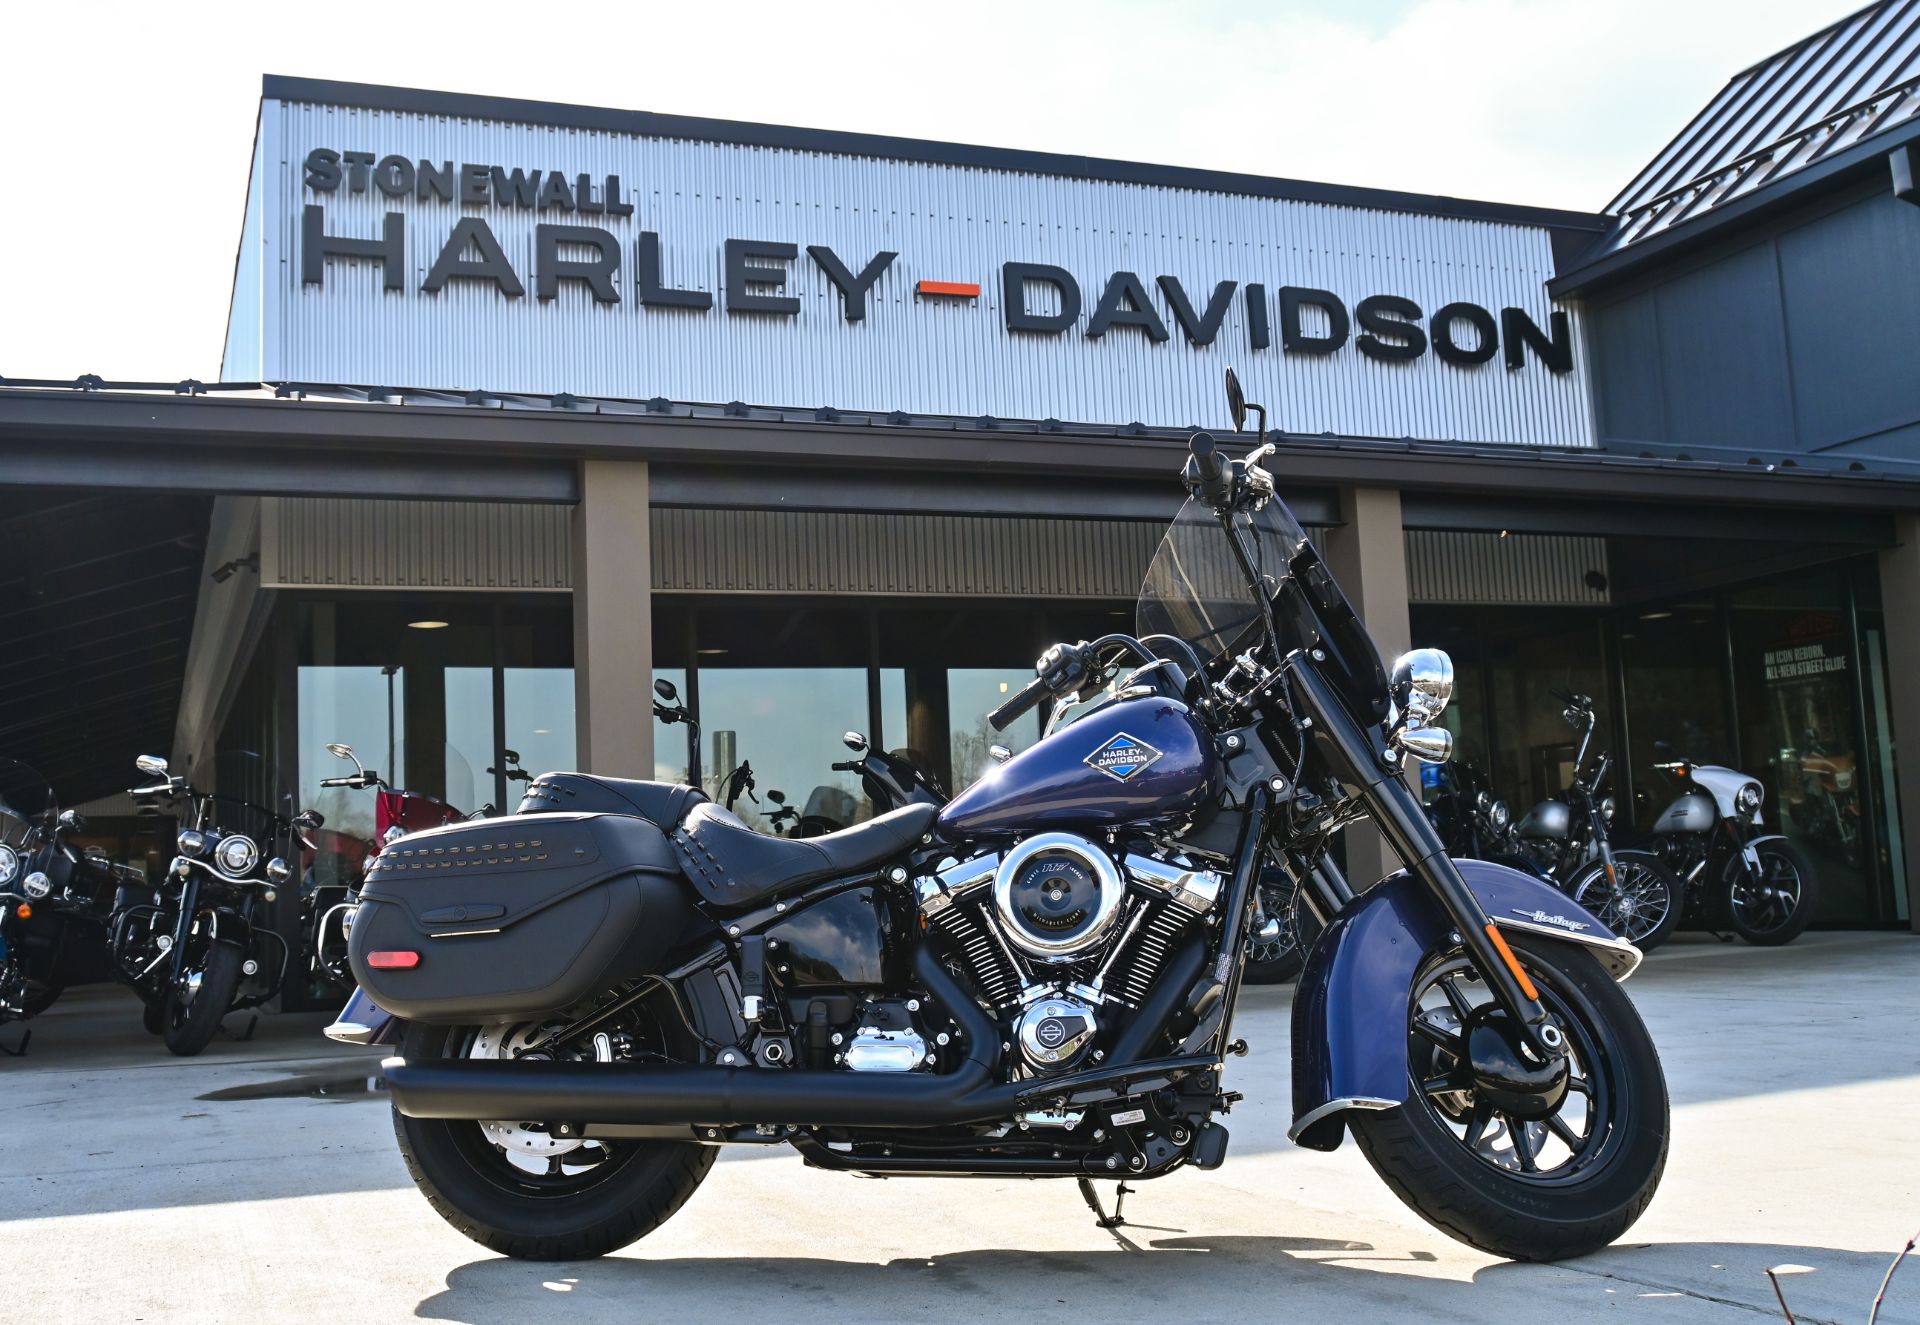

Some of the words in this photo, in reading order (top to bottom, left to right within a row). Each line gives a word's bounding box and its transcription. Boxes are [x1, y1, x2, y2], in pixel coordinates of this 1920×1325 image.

[304, 147, 635, 217] STONEWALL
[1797, 659, 1824, 675] STREET
[1825, 656, 1847, 671] GLIDE
[1098, 755, 1148, 766] DAVIDSON
[1530, 910, 1590, 931] Heritage
